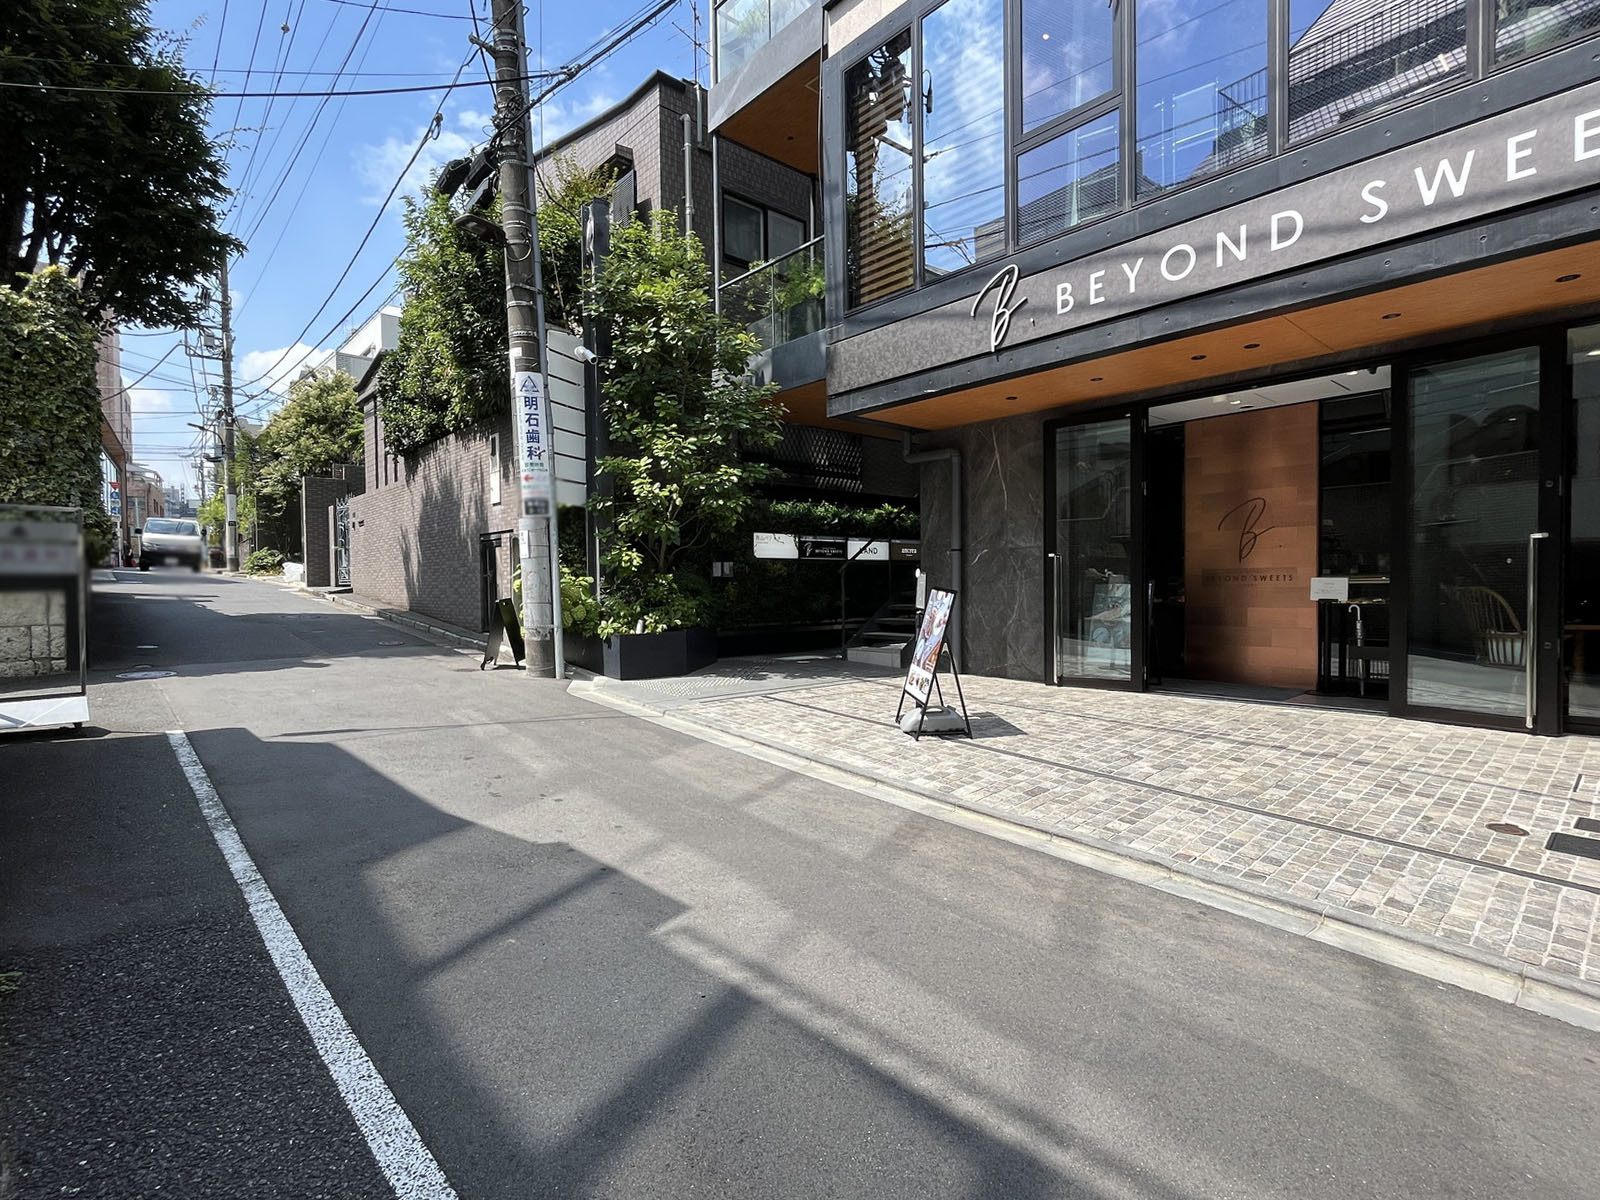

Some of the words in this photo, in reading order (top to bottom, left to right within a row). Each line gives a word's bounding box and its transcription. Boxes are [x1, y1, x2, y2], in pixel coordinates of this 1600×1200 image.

[1056, 209, 1304, 315] BEYOND
[1359, 108, 1600, 223] SWEE
[524, 396, 542, 461] 明石歯科
[1253, 574, 1293, 582] SWEETS
